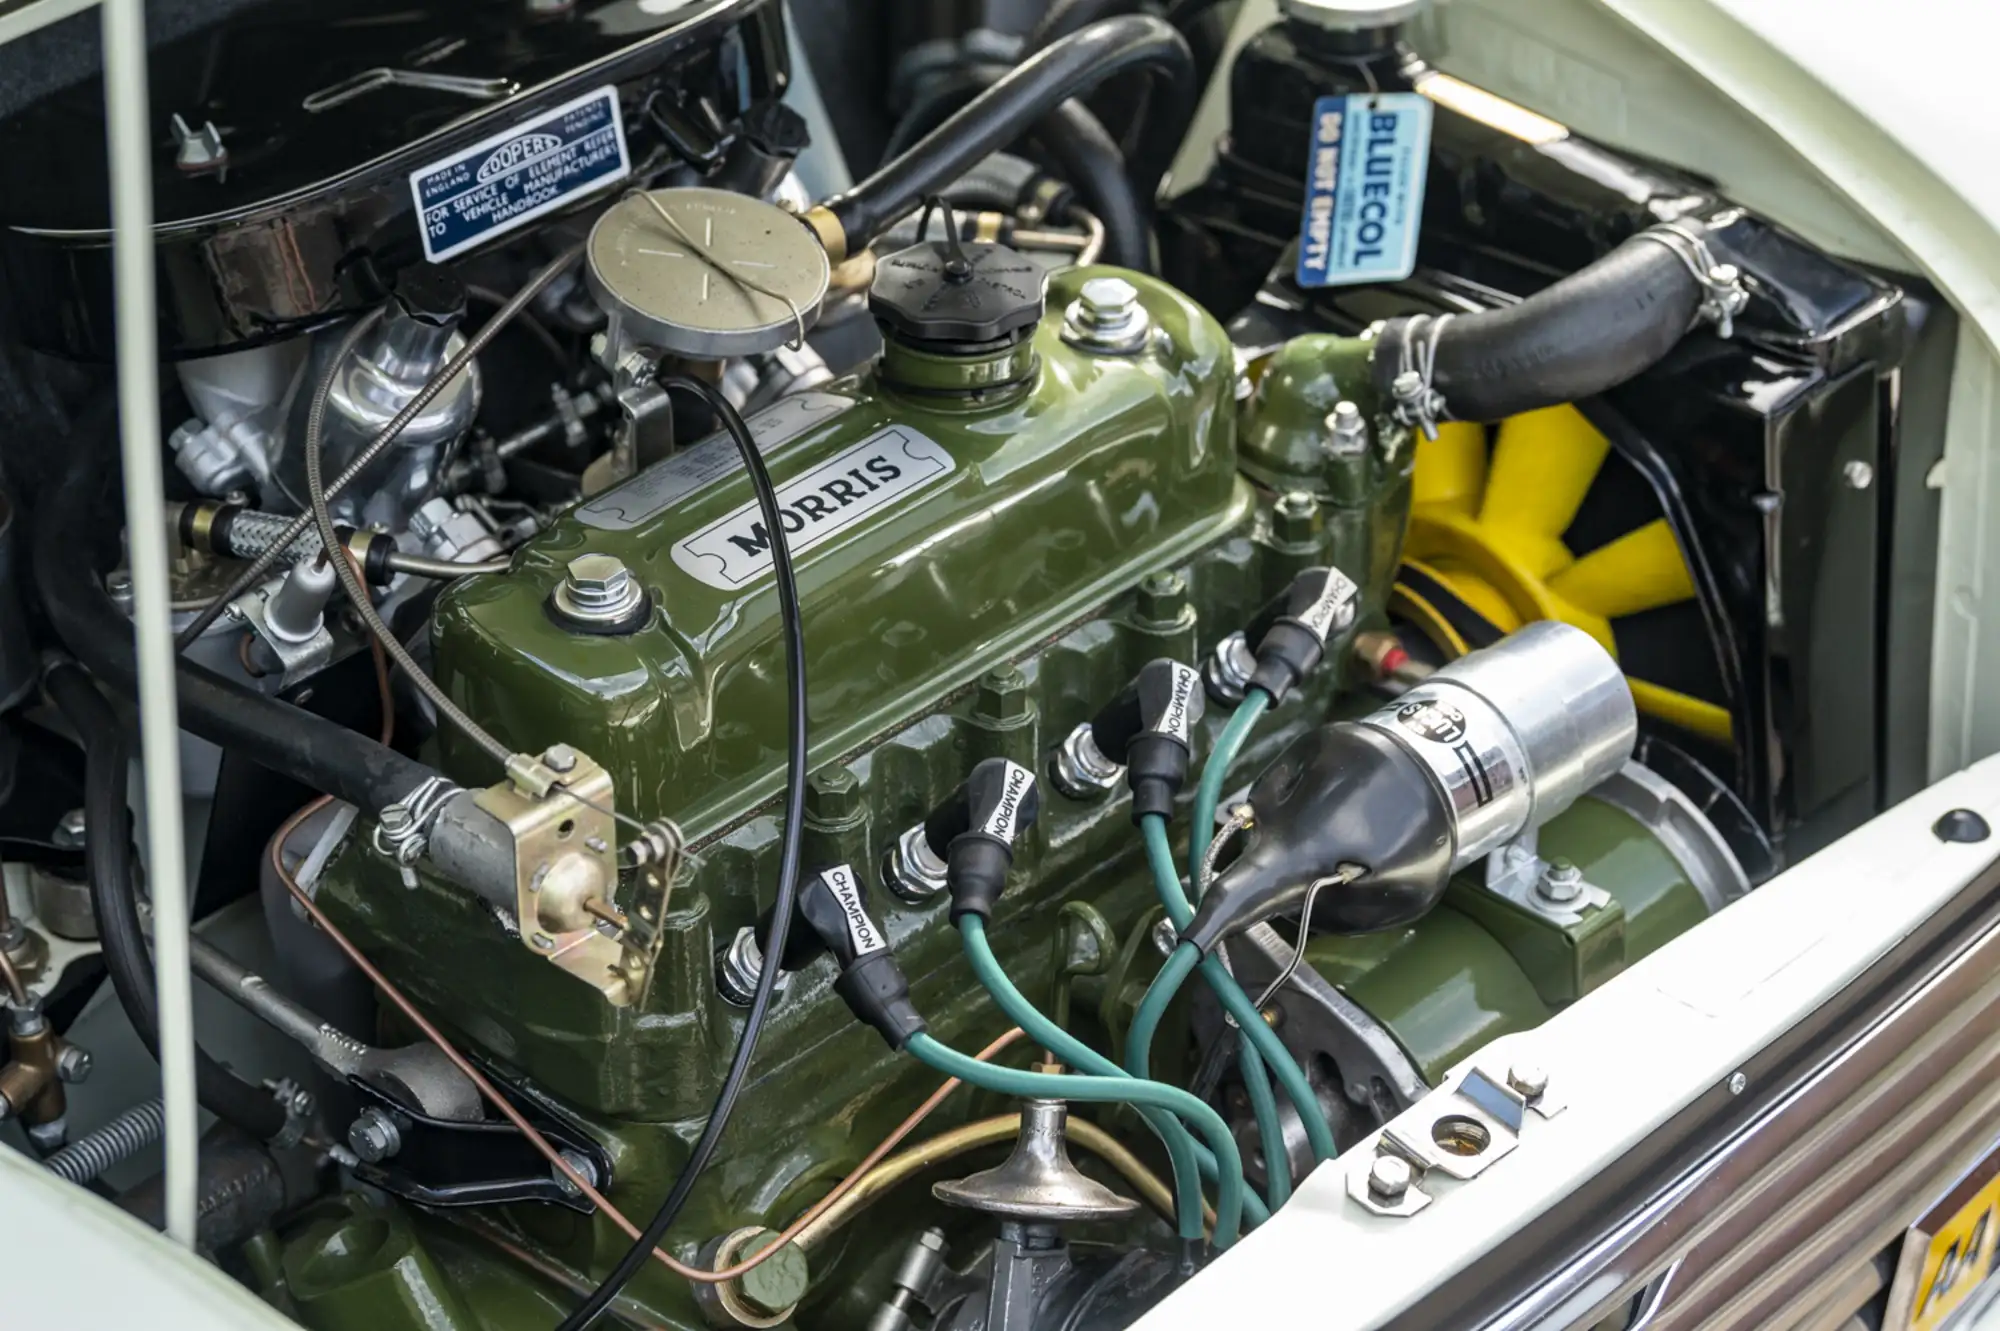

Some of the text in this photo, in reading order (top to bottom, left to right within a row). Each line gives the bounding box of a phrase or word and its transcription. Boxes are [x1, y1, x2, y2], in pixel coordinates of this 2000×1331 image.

[426, 131, 615, 225] FOR SERVICE OF ELEMENT REFER
[426, 172, 470, 198] ENGLAND
[427, 164, 467, 185] MADE IN
[481, 137, 557, 178] COOPERS
[1304, 112, 1342, 271] DO NOT EMPTY
[1353, 113, 1397, 266] BLUECOL
[429, 222, 447, 238] TO
[462, 194, 508, 222] VEHICLE
[728, 454, 901, 557] MORRIS
[1168, 668, 1191, 735] CHAMPION
[1402, 703, 1461, 741] LUAS
[993, 768, 1025, 838] CHAMPION
[832, 871, 875, 948] CHAMPION
